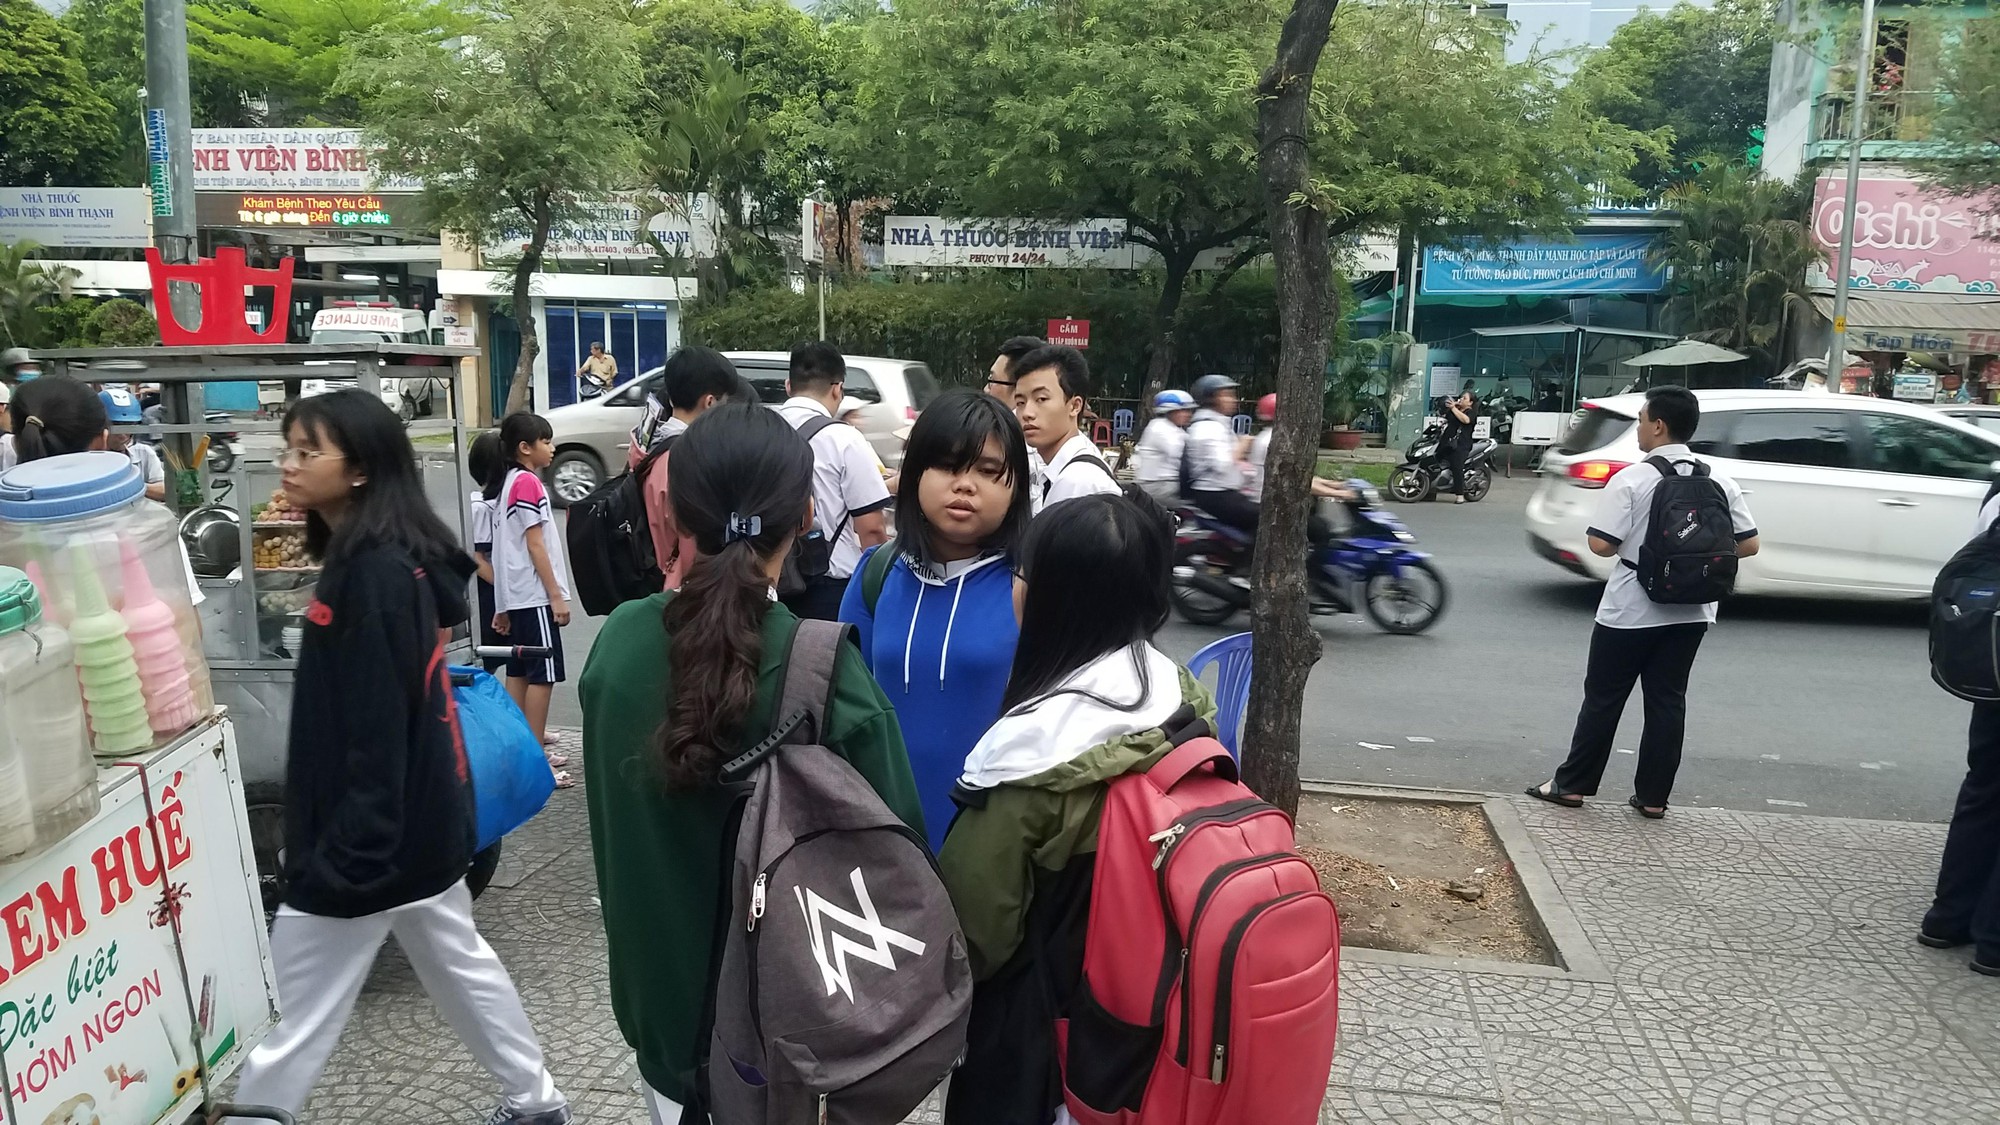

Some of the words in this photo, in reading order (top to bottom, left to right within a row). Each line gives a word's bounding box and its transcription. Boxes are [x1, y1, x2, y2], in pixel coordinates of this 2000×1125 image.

[207, 133, 236, 144] BAN
[239, 131, 280, 144] NHÂN
[283, 131, 312, 144] DÂN
[315, 131, 355, 147] QUẬN
[192, 148, 230, 172] NH
[236, 145, 298, 177] VIỆN
[305, 144, 369, 172] BÌNH
[300, 176, 323, 187] BÌNH
[325, 178, 360, 189] THẠNH
[21, 191, 43, 204] NHÀ
[47, 191, 81, 204] THUỐC
[243, 197, 274, 208] Khám
[277, 197, 303, 210] Bệnh
[305, 197, 332, 208] Theo
[334, 196, 355, 208] Yêu
[358, 195, 380, 209] Cầu
[0, 206, 19, 219] ỆNH
[21, 206, 45, 220] VIỆN
[49, 206, 74, 218] BÌNH
[77, 208, 114, 221] THẠNH
[310, 211, 331, 222] Đến
[333, 213, 340, 222] 6
[341, 212, 359, 225] giờ
[1817, 198, 1939, 249] Oishi
[574, 227, 607, 243] QUẬN
[890, 224, 934, 246] NHÀ
[940, 221, 1008, 248] THUỐC
[1014, 227, 1071, 251] BỆNH
[1076, 227, 1126, 252] VIỆN
[969, 254, 996, 265] PHỤC
[997, 254, 1010, 264] VỤ
[1011, 252, 1046, 265] 24/24
[1546, 250, 1569, 263] MẠNH
[1570, 250, 1588, 263] HỌC
[1589, 247, 1605, 263] TẬP
[1606, 247, 1617, 260] VÀ
[1494, 268, 1511, 282] ĐẠO
[1533, 268, 1560, 280] PHONG
[1562, 265, 1584, 280] CÁCH
[1585, 263, 1598, 279] HỒ
[1600, 265, 1615, 279] CHÍ
[1615, 268, 1637, 279] MINH
[1059, 321, 1078, 333] CẤM
[1863, 331, 1904, 351] Tạp
[1911, 332, 1954, 350] Hóa
[0, 865, 87, 984] EM
[91, 770, 192, 915] HUẾ
[67, 939, 120, 1005] biệt
[0, 1035, 77, 1121] HƠM
[82, 969, 162, 1053] NGON
